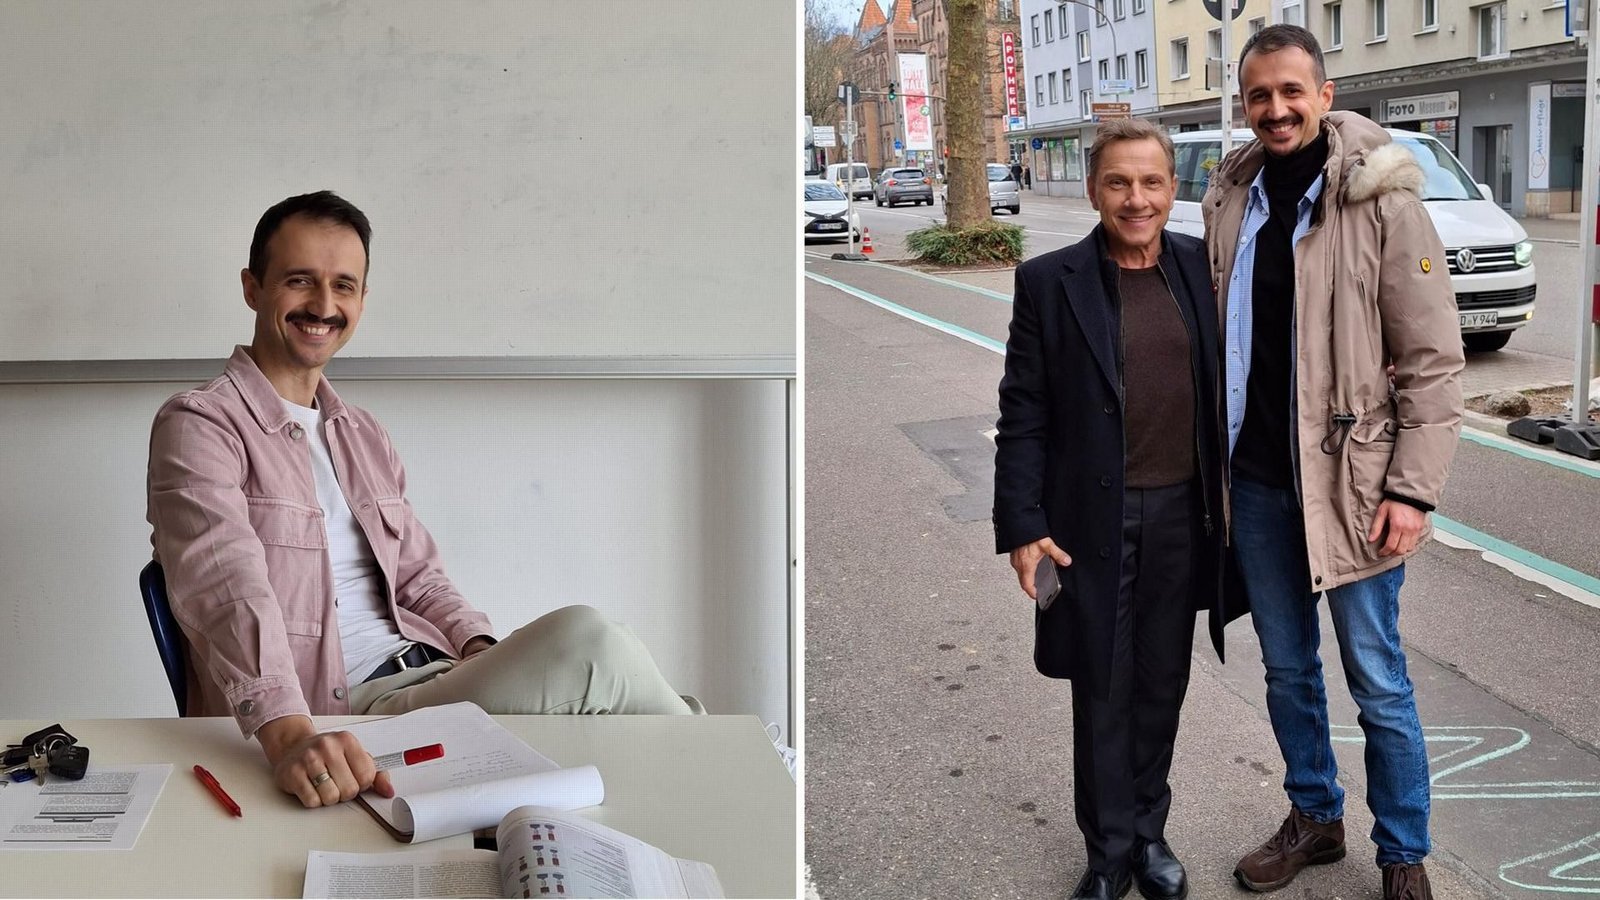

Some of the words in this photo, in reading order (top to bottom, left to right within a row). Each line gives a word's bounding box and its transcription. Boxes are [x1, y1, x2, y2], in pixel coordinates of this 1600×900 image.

[1005, 35, 1017, 115] APOTHEKE
[1389, 104, 1415, 116] FOTO
[1472, 315, 1478, 325] Y
[1480, 313, 1496, 325] 944
